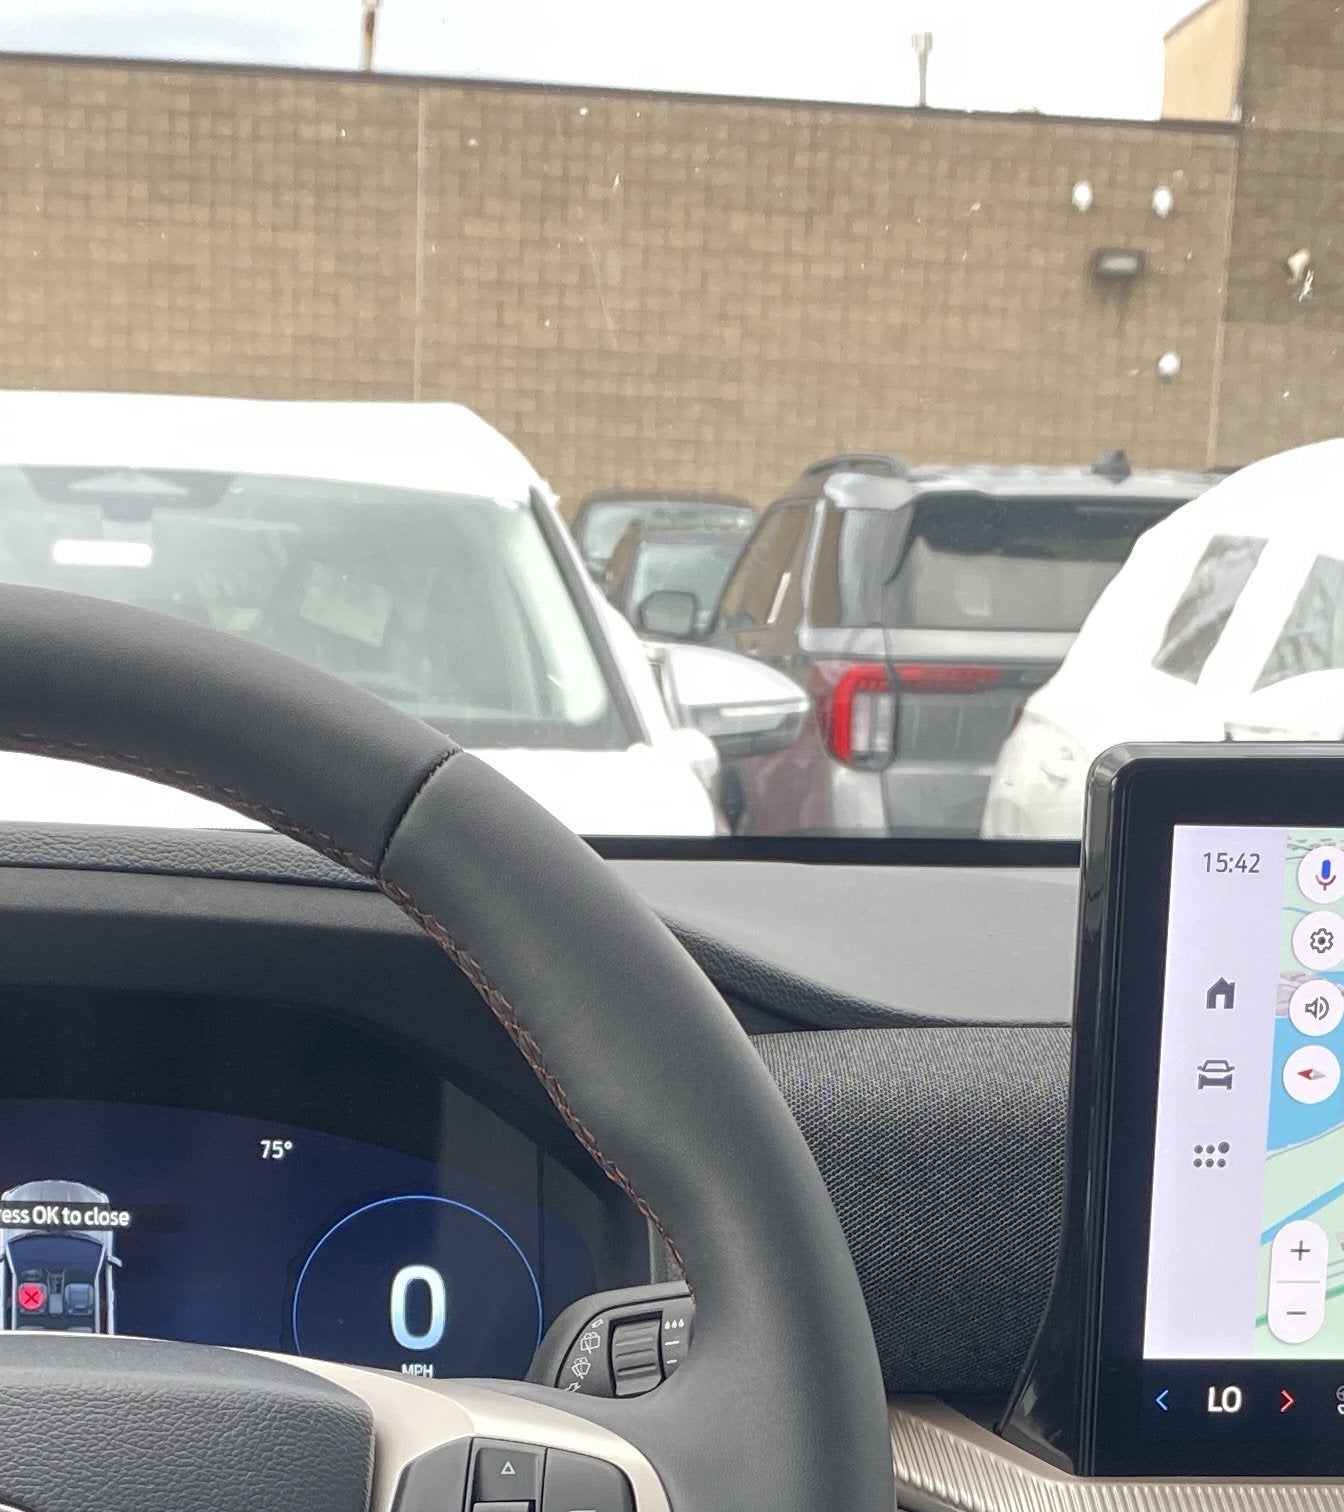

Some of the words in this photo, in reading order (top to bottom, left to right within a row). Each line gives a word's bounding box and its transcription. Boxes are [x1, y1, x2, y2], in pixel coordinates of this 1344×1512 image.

[1203, 852, 1260, 873] 15:42
[259, 1140, 293, 1159] 75°
[32, 1205, 59, 1225] OK
[61, 1207, 82, 1225] to
[84, 1206, 131, 1227] close
[390, 1264, 446, 1350] 0
[401, 1363, 434, 1379] MPH
[1207, 1386, 1242, 1412] LO
